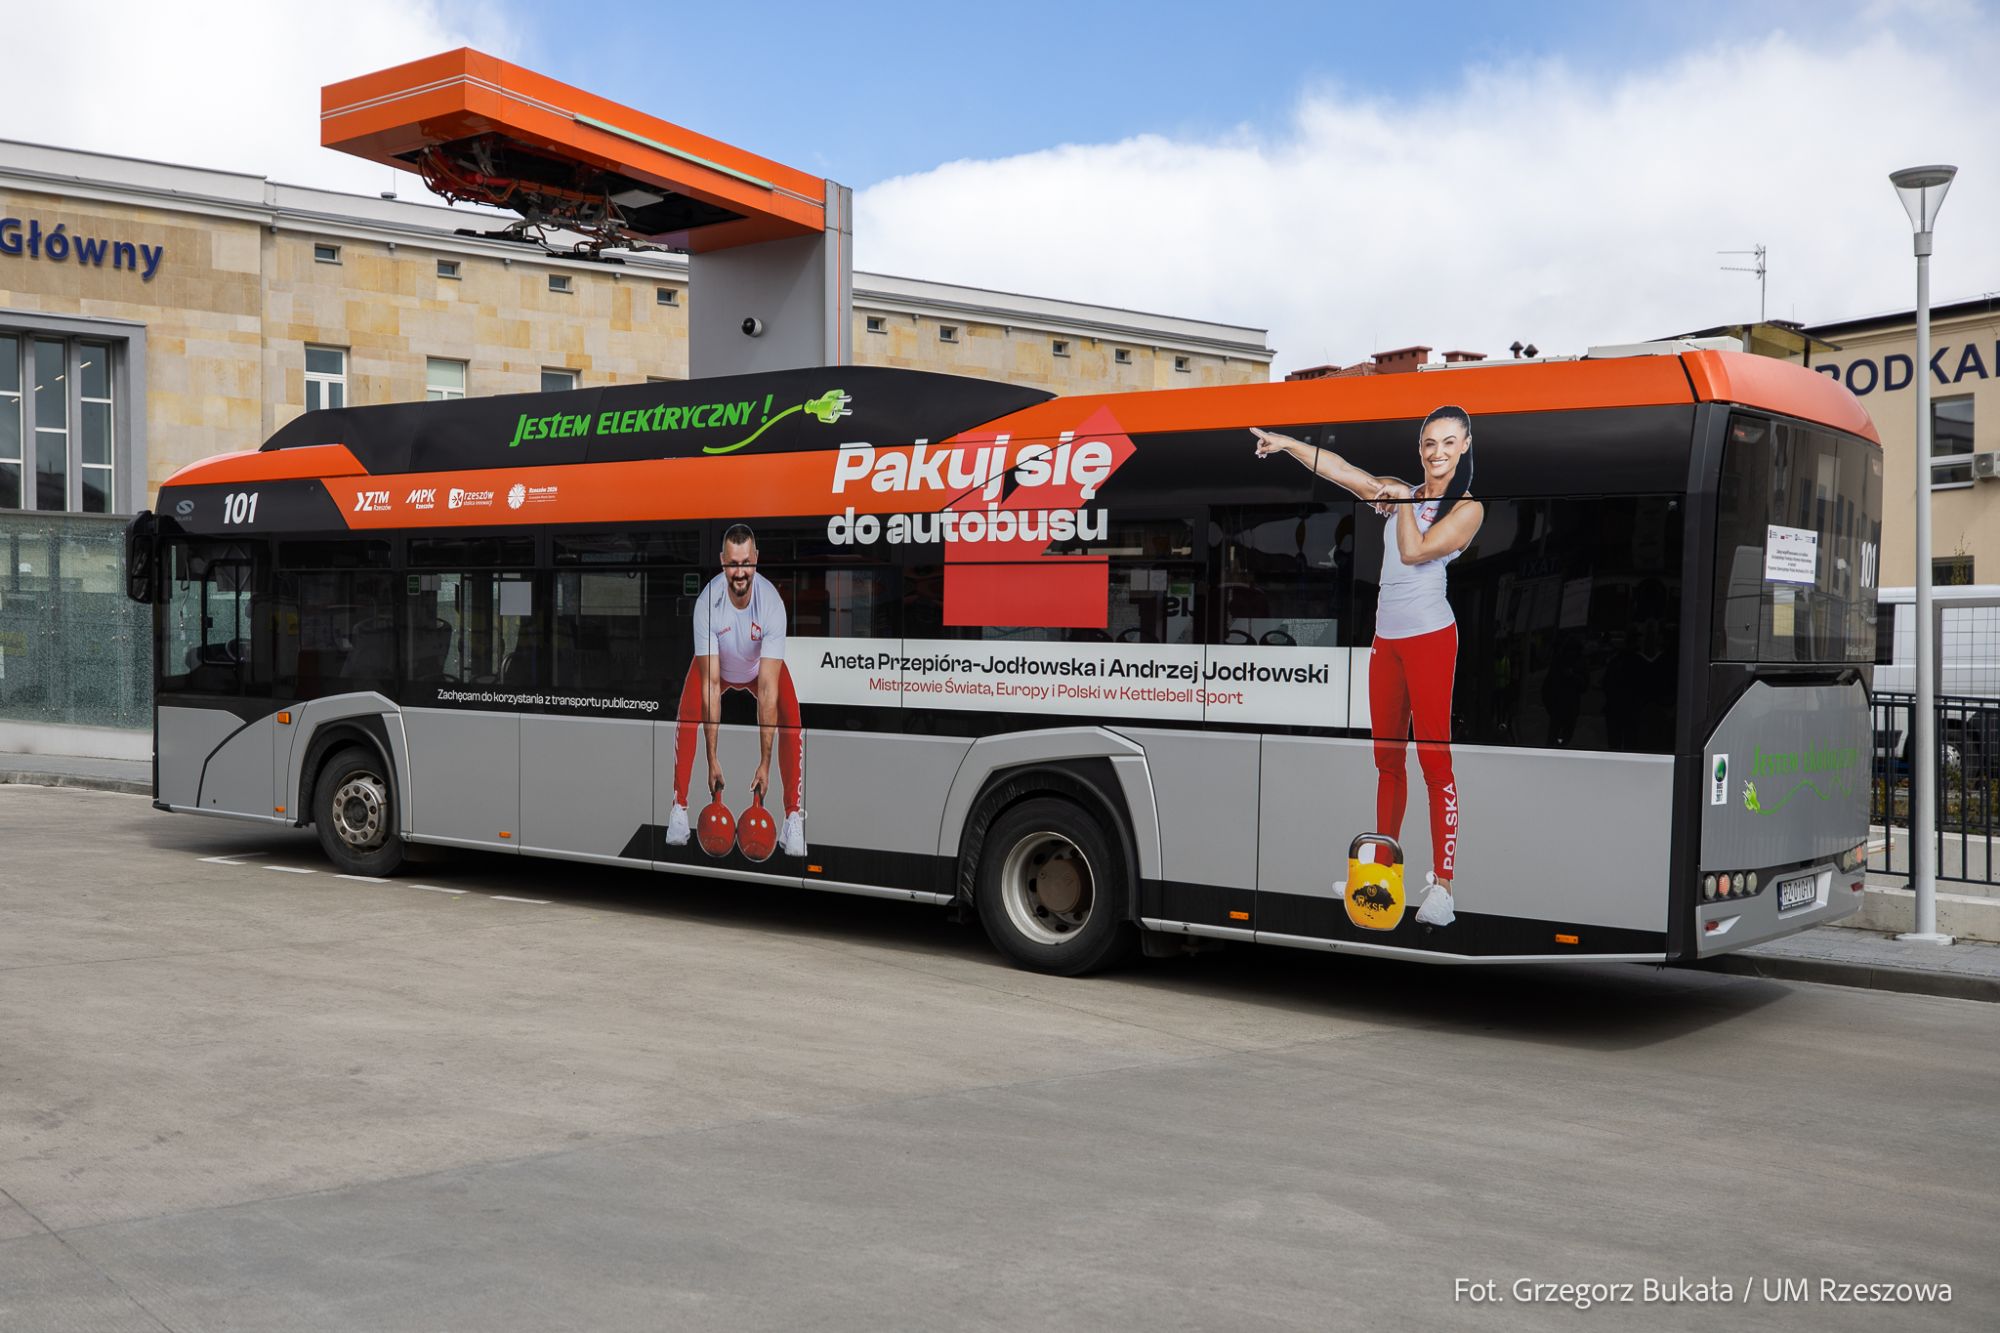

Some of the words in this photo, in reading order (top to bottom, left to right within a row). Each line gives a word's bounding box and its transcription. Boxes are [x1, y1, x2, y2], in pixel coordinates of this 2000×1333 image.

[0, 218, 164, 281] Główny
[1815, 340, 2000, 397] ODKA
[832, 438, 1010, 501] Pakuj
[1014, 431, 1113, 500] się
[223, 492, 259, 525] 101
[405, 488, 437, 503] MPK
[827, 507, 880, 545] do
[886, 503, 1108, 544] autobusu
[1860, 541, 1877, 588] 101
[820, 652, 875, 671] Aneta
[878, 653, 1096, 678] Przepióra-Jodłowska
[1100, 658, 1105, 676] i
[1109, 659, 1199, 683] Andrzej
[1203, 662, 1329, 684] Jodłowski
[437, 688, 481, 703] Zachęcam
[481, 691, 492, 702] do
[493, 692, 543, 706] korzystania
[544, 696, 551, 705] z
[551, 695, 601, 709] transportu
[602, 697, 659, 711] publicznego
[869, 677, 943, 693] Mistrzowie
[944, 676, 994, 697] Świata,
[996, 682, 1049, 700] Europy
[1052, 684, 1056, 696] i
[1058, 683, 1101, 699] Polski
[1103, 688, 1117, 699] w
[1120, 686, 1193, 704] Kettlebell
[1196, 689, 1243, 706] Sport
[1442, 782, 1459, 871] POLSKA
